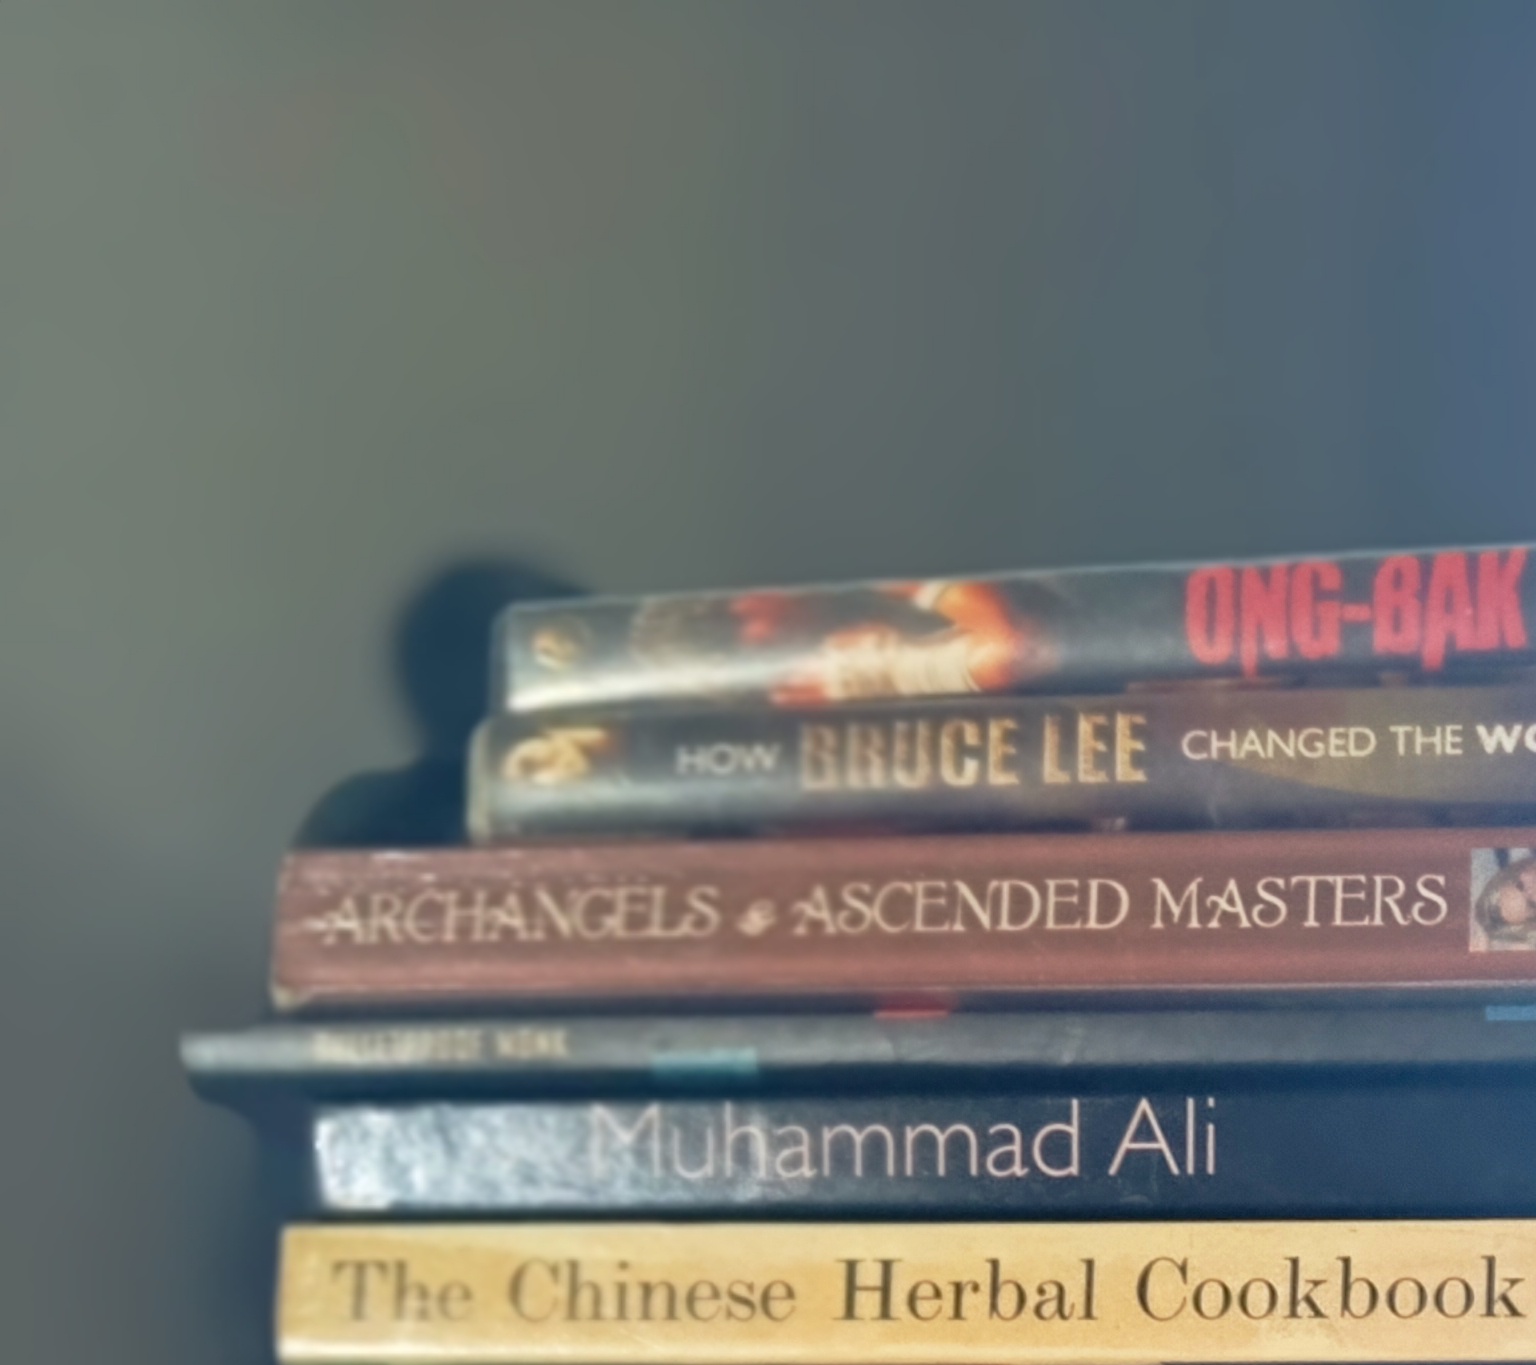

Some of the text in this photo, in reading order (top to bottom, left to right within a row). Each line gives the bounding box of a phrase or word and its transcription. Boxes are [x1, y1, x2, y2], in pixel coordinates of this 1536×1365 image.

[1185, 546, 1528, 677] ONG-BAK
[676, 741, 781, 776] HOW
[800, 718, 1020, 791] BRUCE
[1042, 712, 1148, 785] LEE
[1181, 726, 1376, 762] CHANGED
[1391, 723, 1464, 758] THE
[322, 884, 722, 946] ARCHANGELS
[792, 876, 1129, 933] ASCENDED
[1150, 872, 1449, 930] MASTERS
[590, 1097, 1216, 1180] Muhammad Ali
[330, 1254, 1527, 1324] The Chinese Herbal Cookbook
